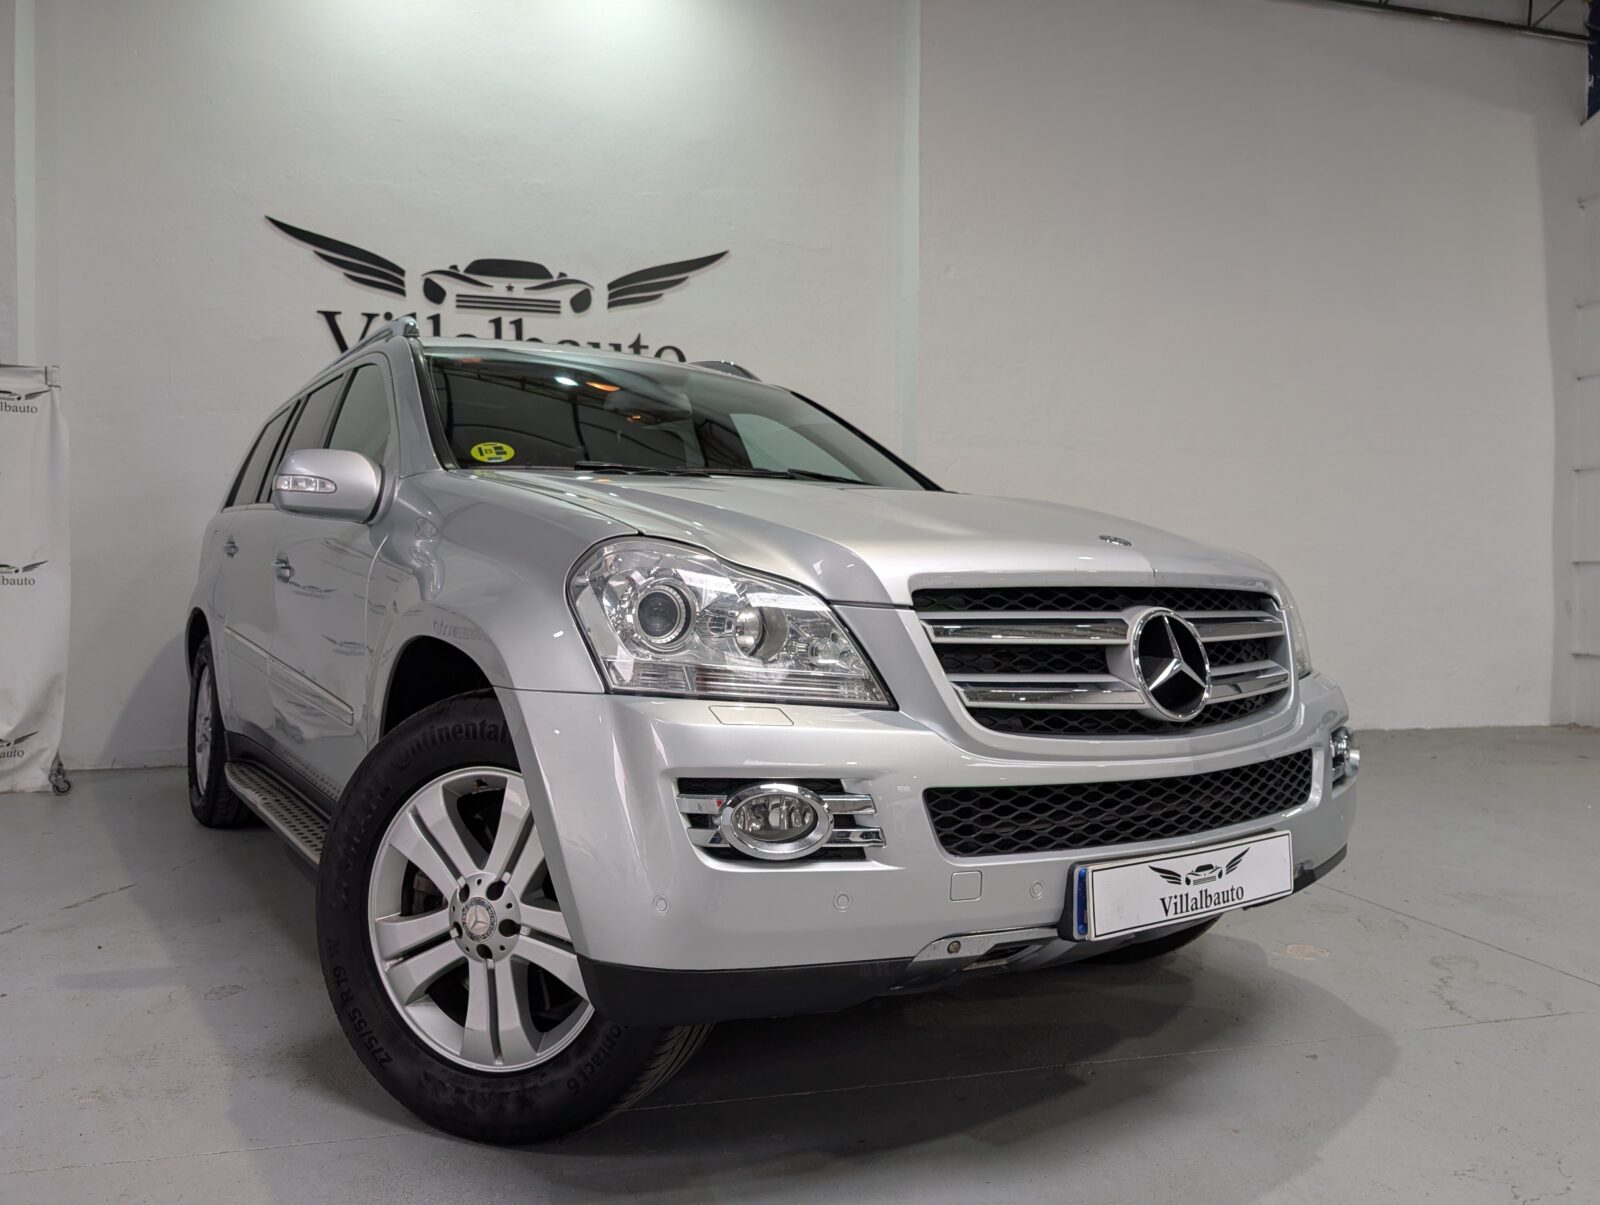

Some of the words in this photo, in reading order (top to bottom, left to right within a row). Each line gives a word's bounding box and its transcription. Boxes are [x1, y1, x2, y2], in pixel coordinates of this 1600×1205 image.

[1159, 885, 1245, 917] Villalbauto
[347, 1007, 394, 1071] 275/55
[577, 1023, 629, 1083] ontact
